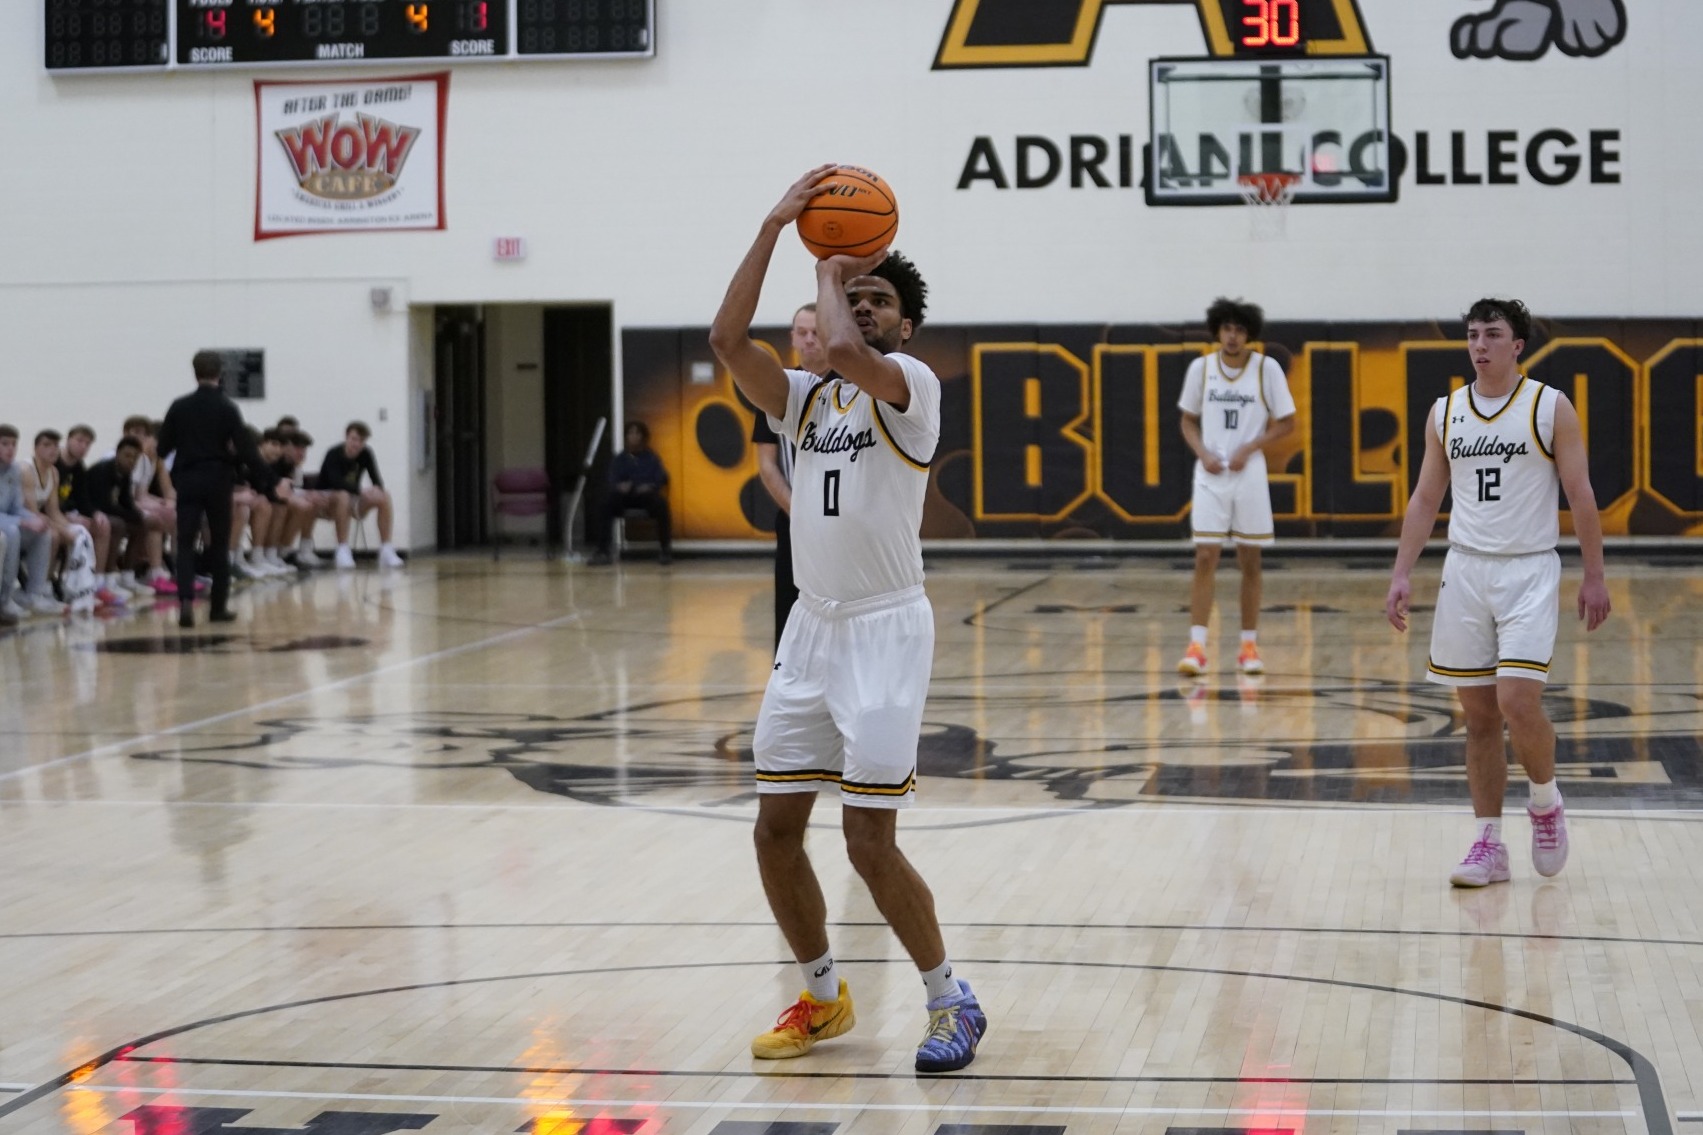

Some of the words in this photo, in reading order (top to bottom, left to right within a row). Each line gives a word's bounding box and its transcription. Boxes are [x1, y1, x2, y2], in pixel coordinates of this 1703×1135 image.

[206, 8, 226, 36] 4
[254, 8, 275, 37] 4
[406, 4, 428, 32] 4
[1243, 0, 1299, 46] 30
[191, 46, 233, 62] SCORE
[317, 42, 364, 58] MATCH
[450, 39, 495, 55] SCORE
[275, 111, 421, 184] WOW
[1311, 128, 1621, 188] COLLEGE
[497, 237, 521, 256] EXIT
[1208, 388, 1255, 408] Bulldogs
[1224, 409, 1238, 429] 10
[800, 421, 877, 462] Bulldogs
[1450, 435, 1529, 463] Bulldogs
[823, 469, 841, 517] 0
[1476, 468, 1501, 501] 12
